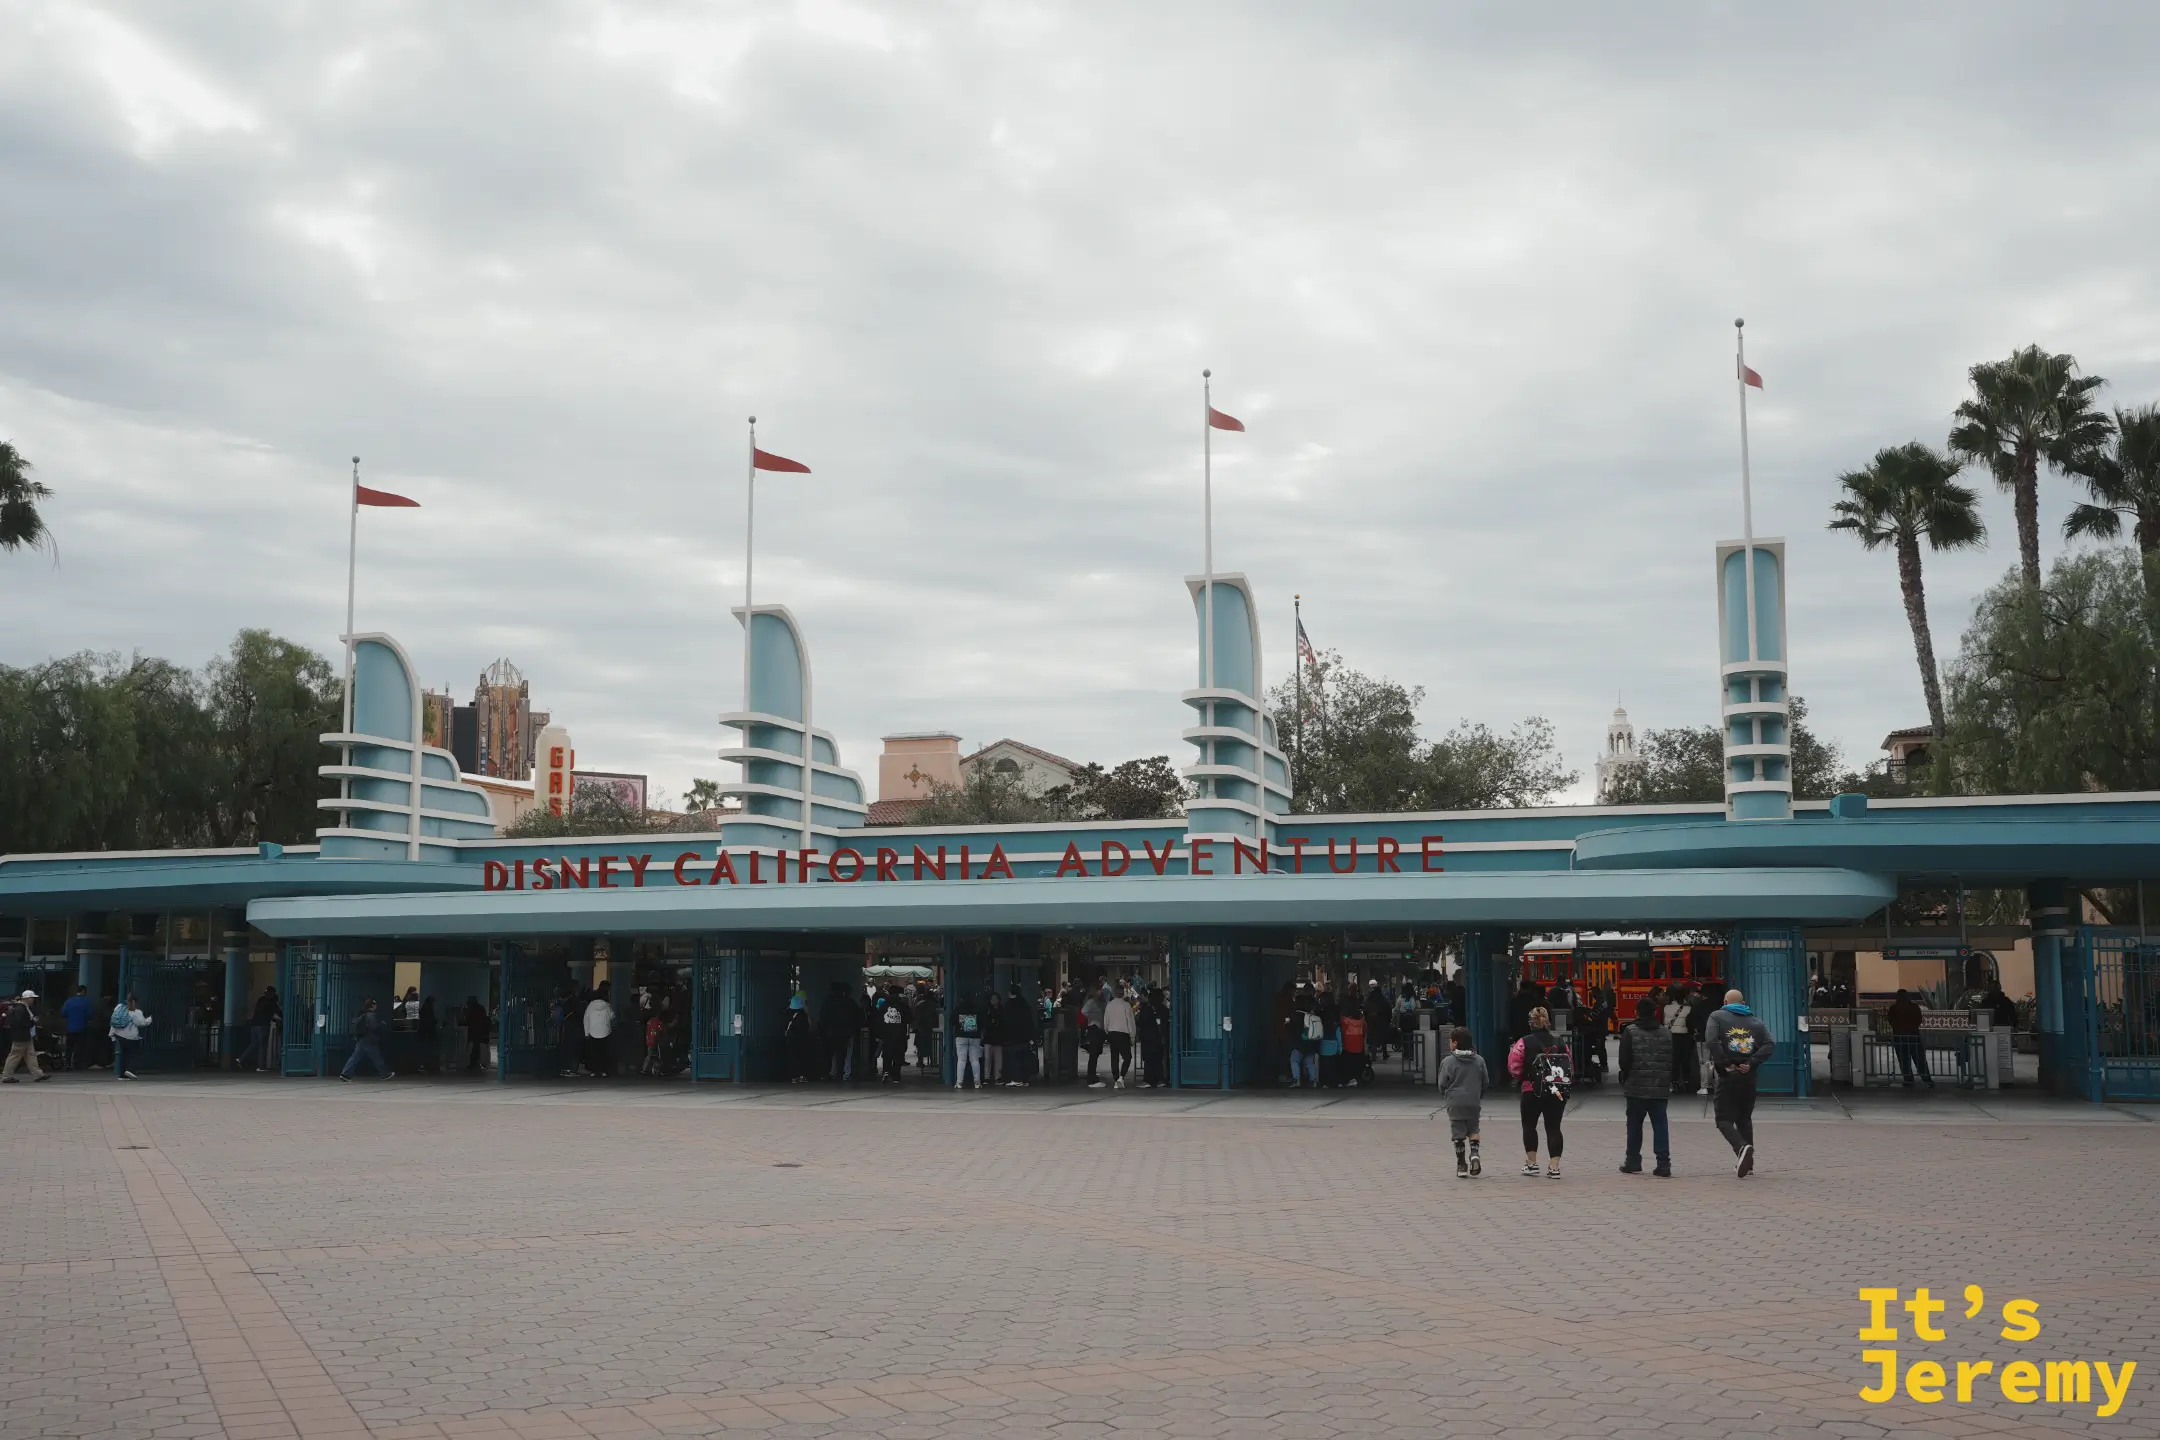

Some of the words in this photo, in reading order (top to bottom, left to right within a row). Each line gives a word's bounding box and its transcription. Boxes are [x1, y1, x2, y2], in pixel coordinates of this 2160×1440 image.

[548, 746, 565, 817] GAS
[484, 854, 651, 891] DISNEY
[673, 842, 1016, 888] CALIFORNIA
[1056, 835, 1444, 878] ADVENTURE
